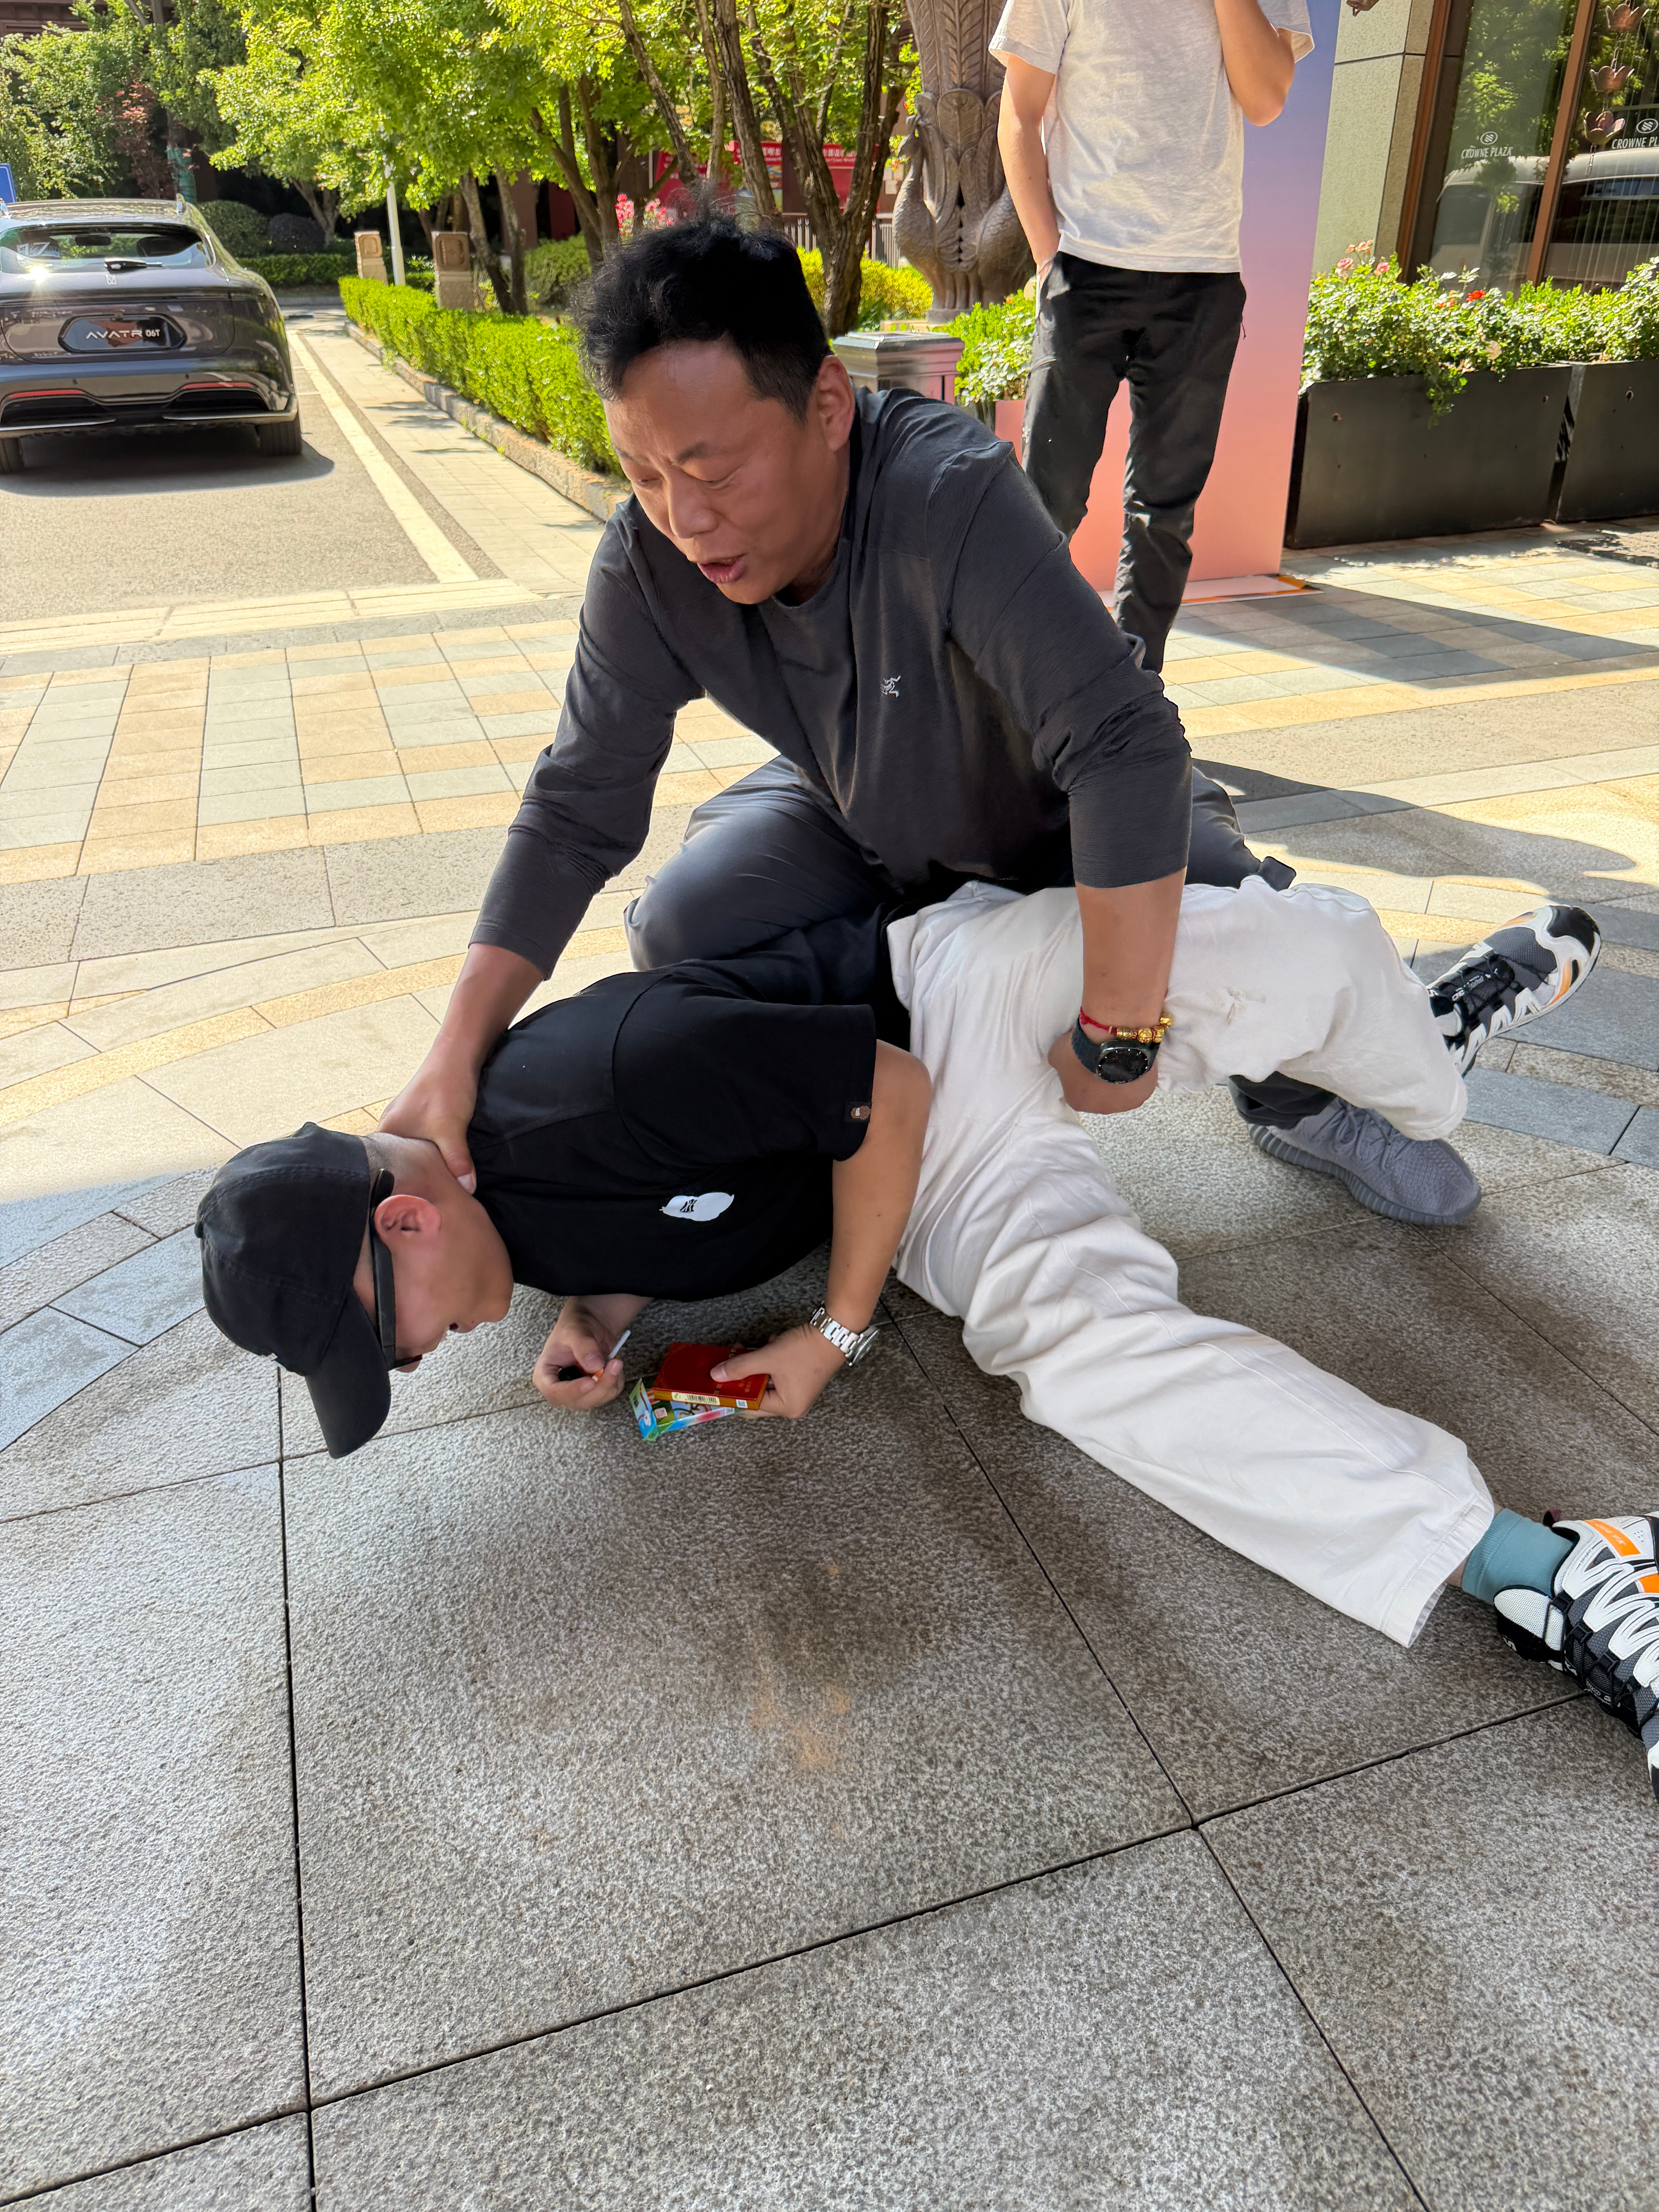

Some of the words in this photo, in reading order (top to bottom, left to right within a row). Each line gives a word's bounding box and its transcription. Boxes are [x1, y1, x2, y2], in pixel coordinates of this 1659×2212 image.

[1612, 137, 1647, 149] CROWNE
[1649, 136, 1659, 147] PL
[1461, 148, 1489, 158] CROWNE
[1491, 147, 1512, 156] PLAZA
[86, 330, 143, 339] AVATR
